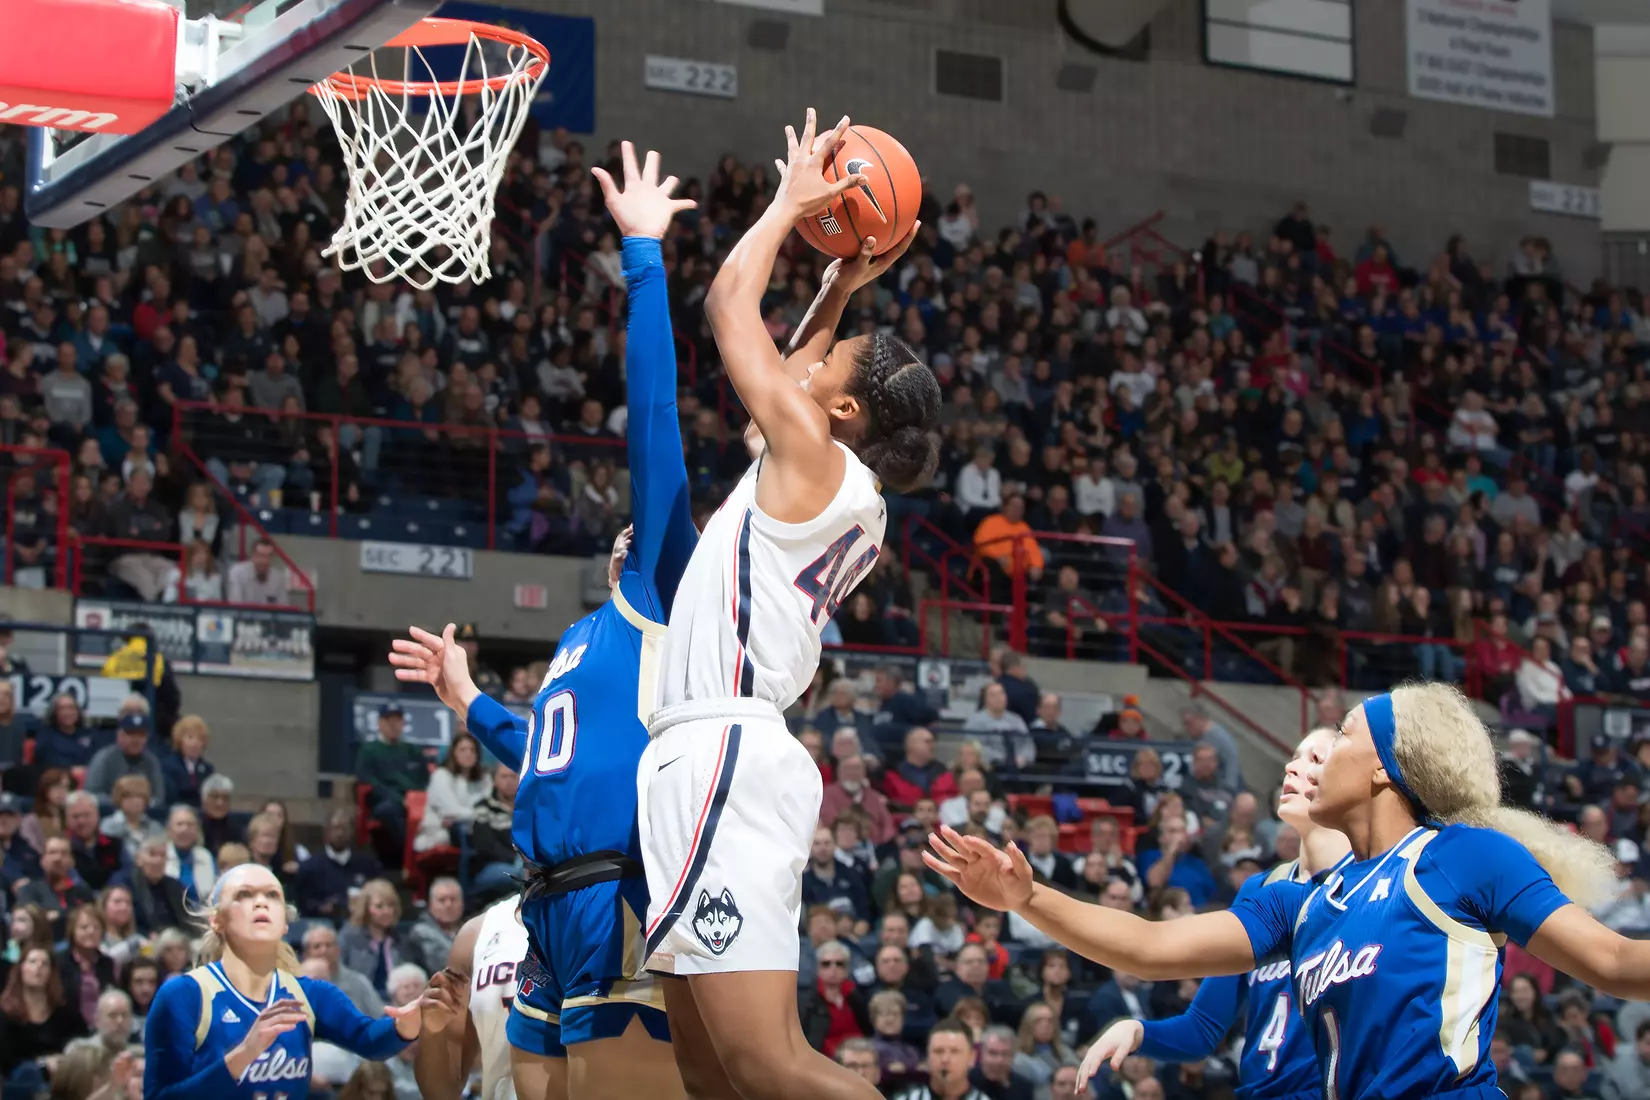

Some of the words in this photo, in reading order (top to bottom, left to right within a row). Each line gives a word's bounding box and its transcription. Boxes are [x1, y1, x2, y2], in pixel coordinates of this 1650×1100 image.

[685, 64, 735, 91] 222
[418, 545, 471, 576] 221
[793, 524, 880, 625] 44
[1087, 753, 1128, 775] SEC
[1295, 940, 1384, 1018] Tulsa
[1258, 992, 1290, 1074] 4
